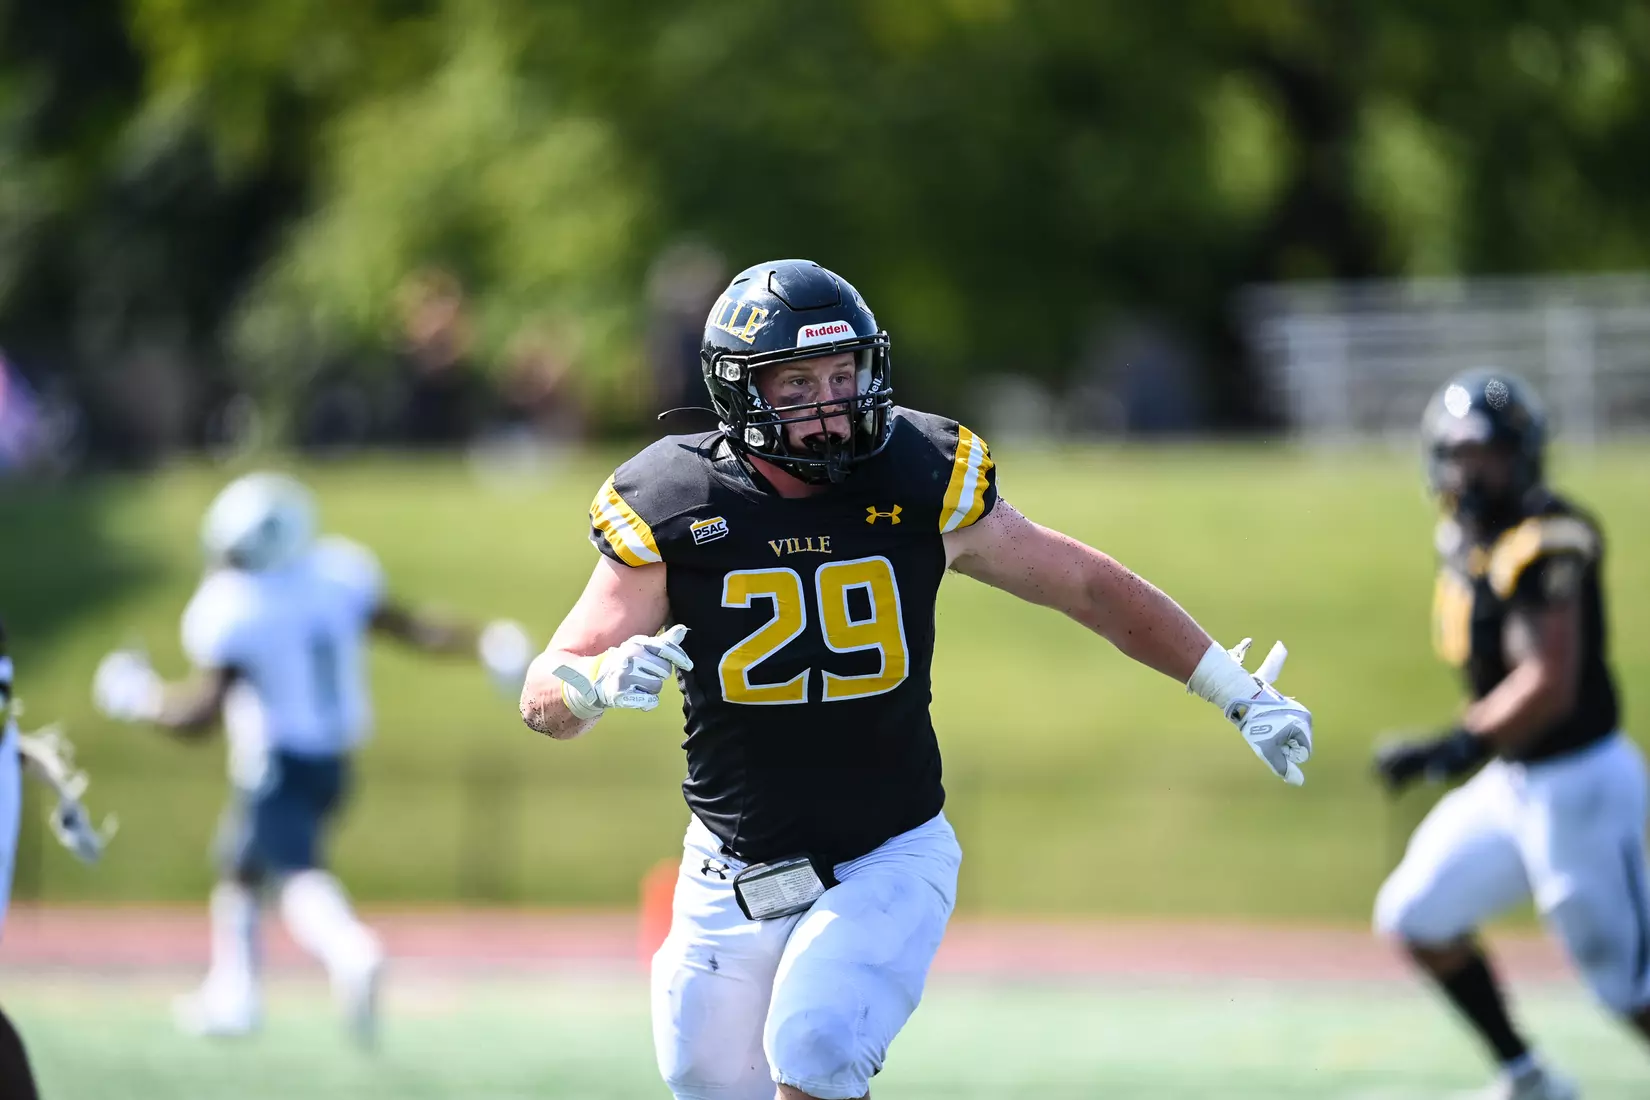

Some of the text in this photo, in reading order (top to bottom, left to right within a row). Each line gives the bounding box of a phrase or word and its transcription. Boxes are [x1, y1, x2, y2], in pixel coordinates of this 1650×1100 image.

[804, 324, 848, 338] Riddell
[693, 521, 726, 539] PSAC
[768, 535, 832, 557] VILLE
[718, 555, 909, 705] 29
